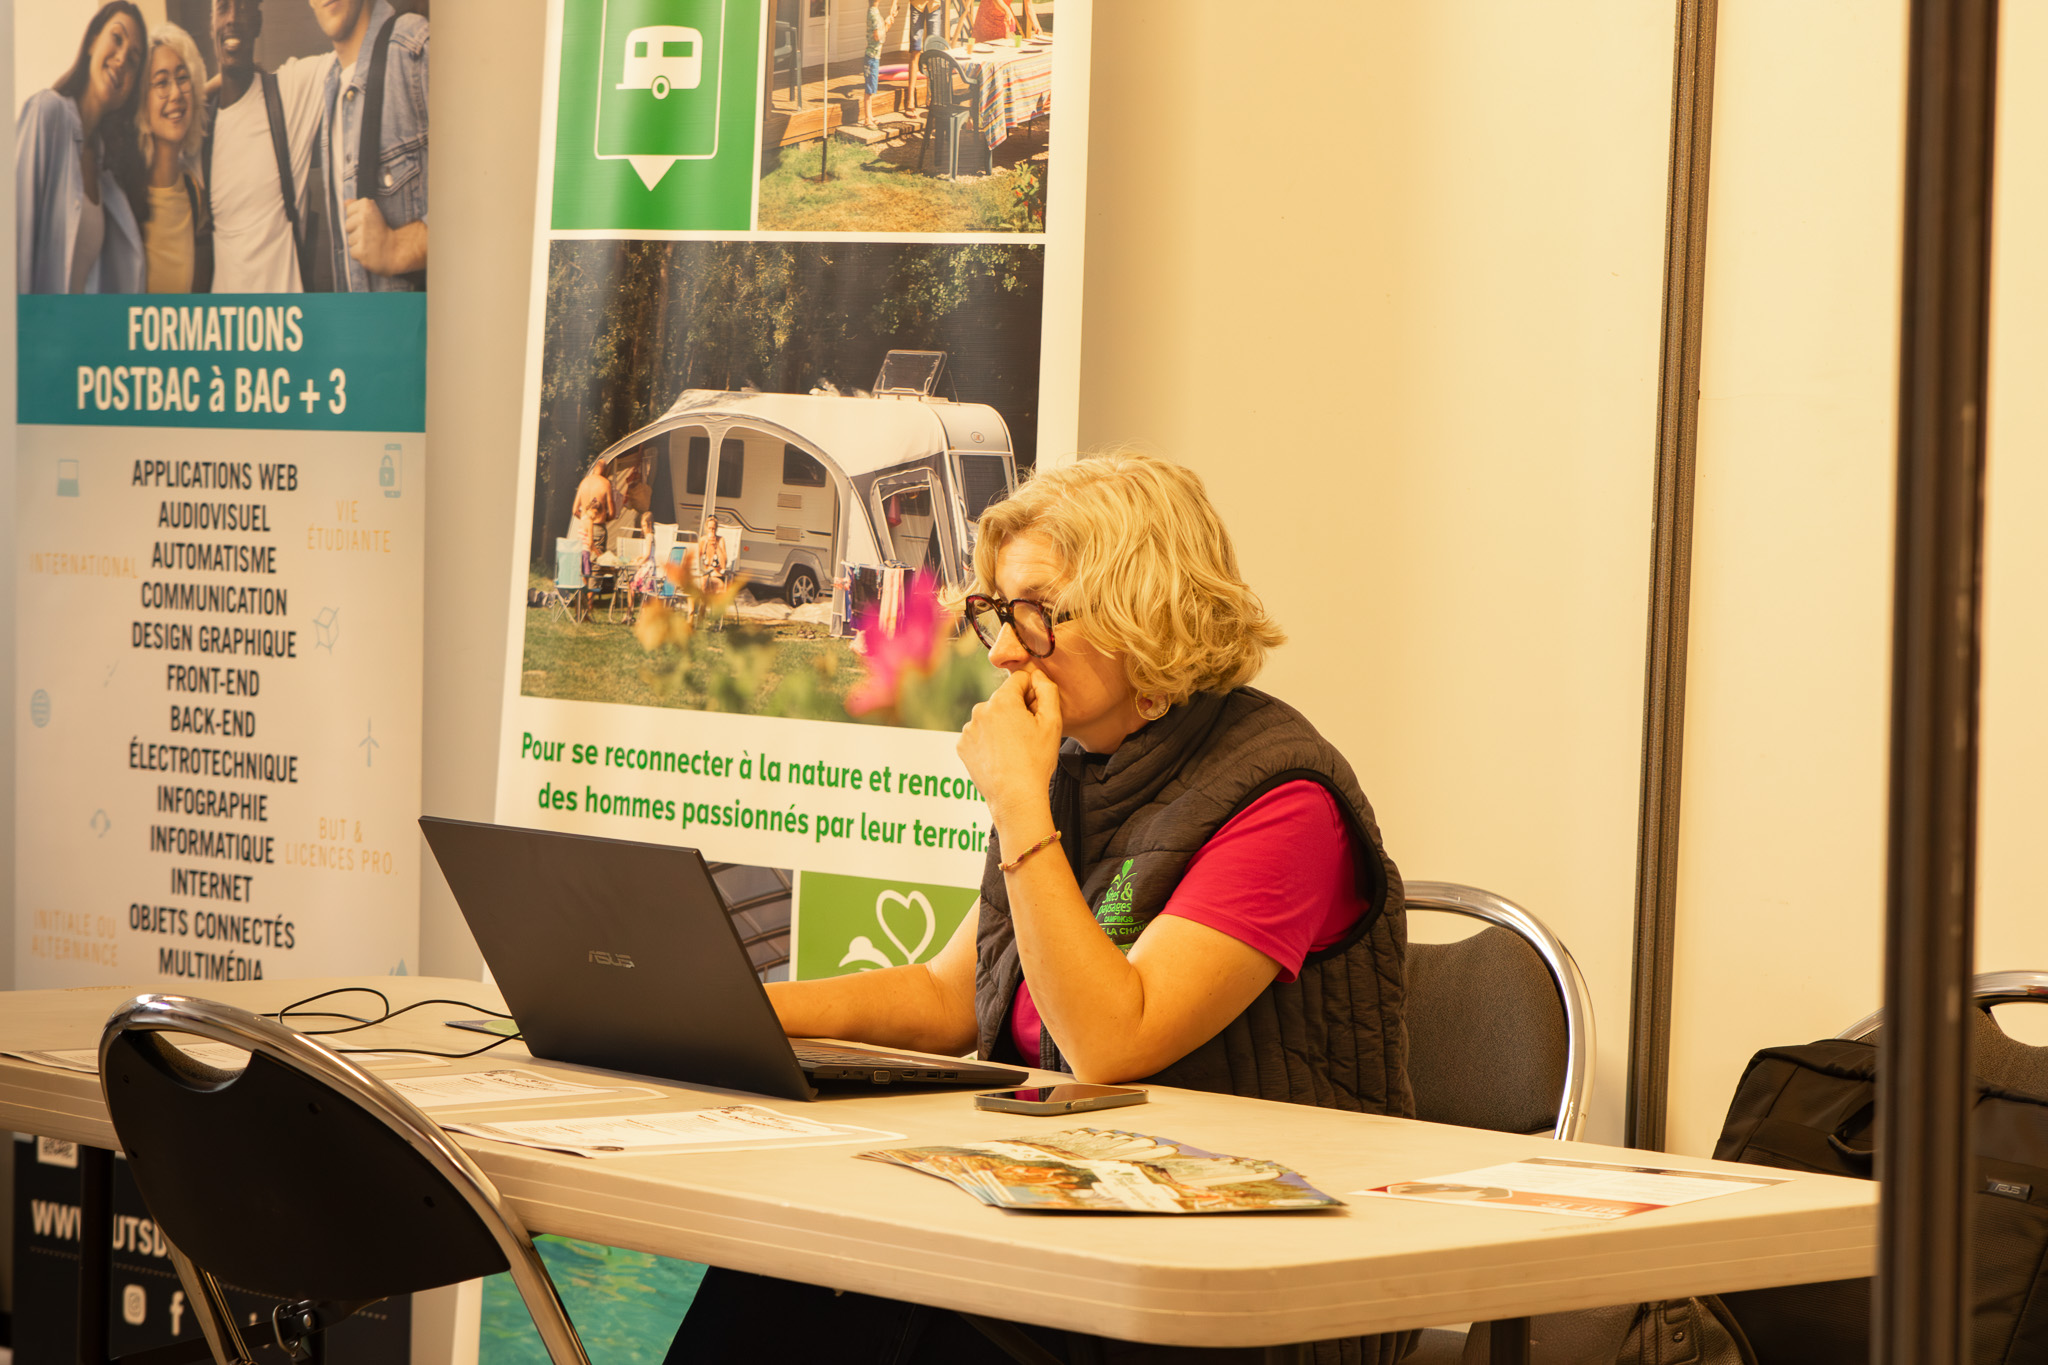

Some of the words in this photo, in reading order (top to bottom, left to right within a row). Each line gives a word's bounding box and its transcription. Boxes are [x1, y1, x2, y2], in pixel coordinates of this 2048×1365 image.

[128, 306, 303, 352] FORMATIONS
[77, 366, 200, 411] POSTBAC
[210, 365, 225, 412] à
[235, 368, 290, 413] BAC
[300, 379, 320, 414] +
[329, 368, 347, 414] 3
[132, 459, 252, 490] APPLICATIONS
[259, 463, 298, 491] WEB
[158, 501, 271, 532] AUDIOVISUEL
[336, 500, 359, 523] VIE
[307, 522, 391, 553] ÉTUDIANTE
[30, 552, 138, 579] INTERNATIONAL
[152, 541, 277, 574] AUTOMATISME
[141, 582, 287, 616] COMMUNICATION
[132, 621, 193, 652] DESIGN
[199, 626, 297, 659] GRAPHIQUE
[167, 664, 260, 697] FRONT-END
[170, 705, 256, 738] BACK-END
[129, 736, 298, 783] ÉLECTROTECHNIQUE
[521, 732, 565, 763] Pour
[571, 741, 598, 765] se
[605, 745, 733, 779] reconnecter
[739, 750, 753, 780] à
[759, 753, 781, 783] la
[788, 759, 863, 791] nature
[869, 766, 892, 793] et
[157, 785, 268, 822] INFOGRAPHIE
[538, 782, 578, 811] des
[585, 786, 675, 821] hommes
[682, 800, 809, 834] passionnés
[815, 814, 854, 843] par
[861, 812, 906, 845] leur
[913, 819, 988, 853] terroir.
[150, 825, 275, 864] INFORMATIQUE
[319, 817, 347, 840] BUT
[354, 820, 363, 843] &
[285, 843, 354, 871] LICENCES
[171, 867, 253, 903] INTERNET
[129, 903, 188, 936] OBJETS
[195, 914, 295, 949] CONNECTÉS
[159, 947, 263, 982] MULTIMÉDIA
[588, 951, 635, 968] ASUS
[1995, 1183, 2021, 1195] ASUS
